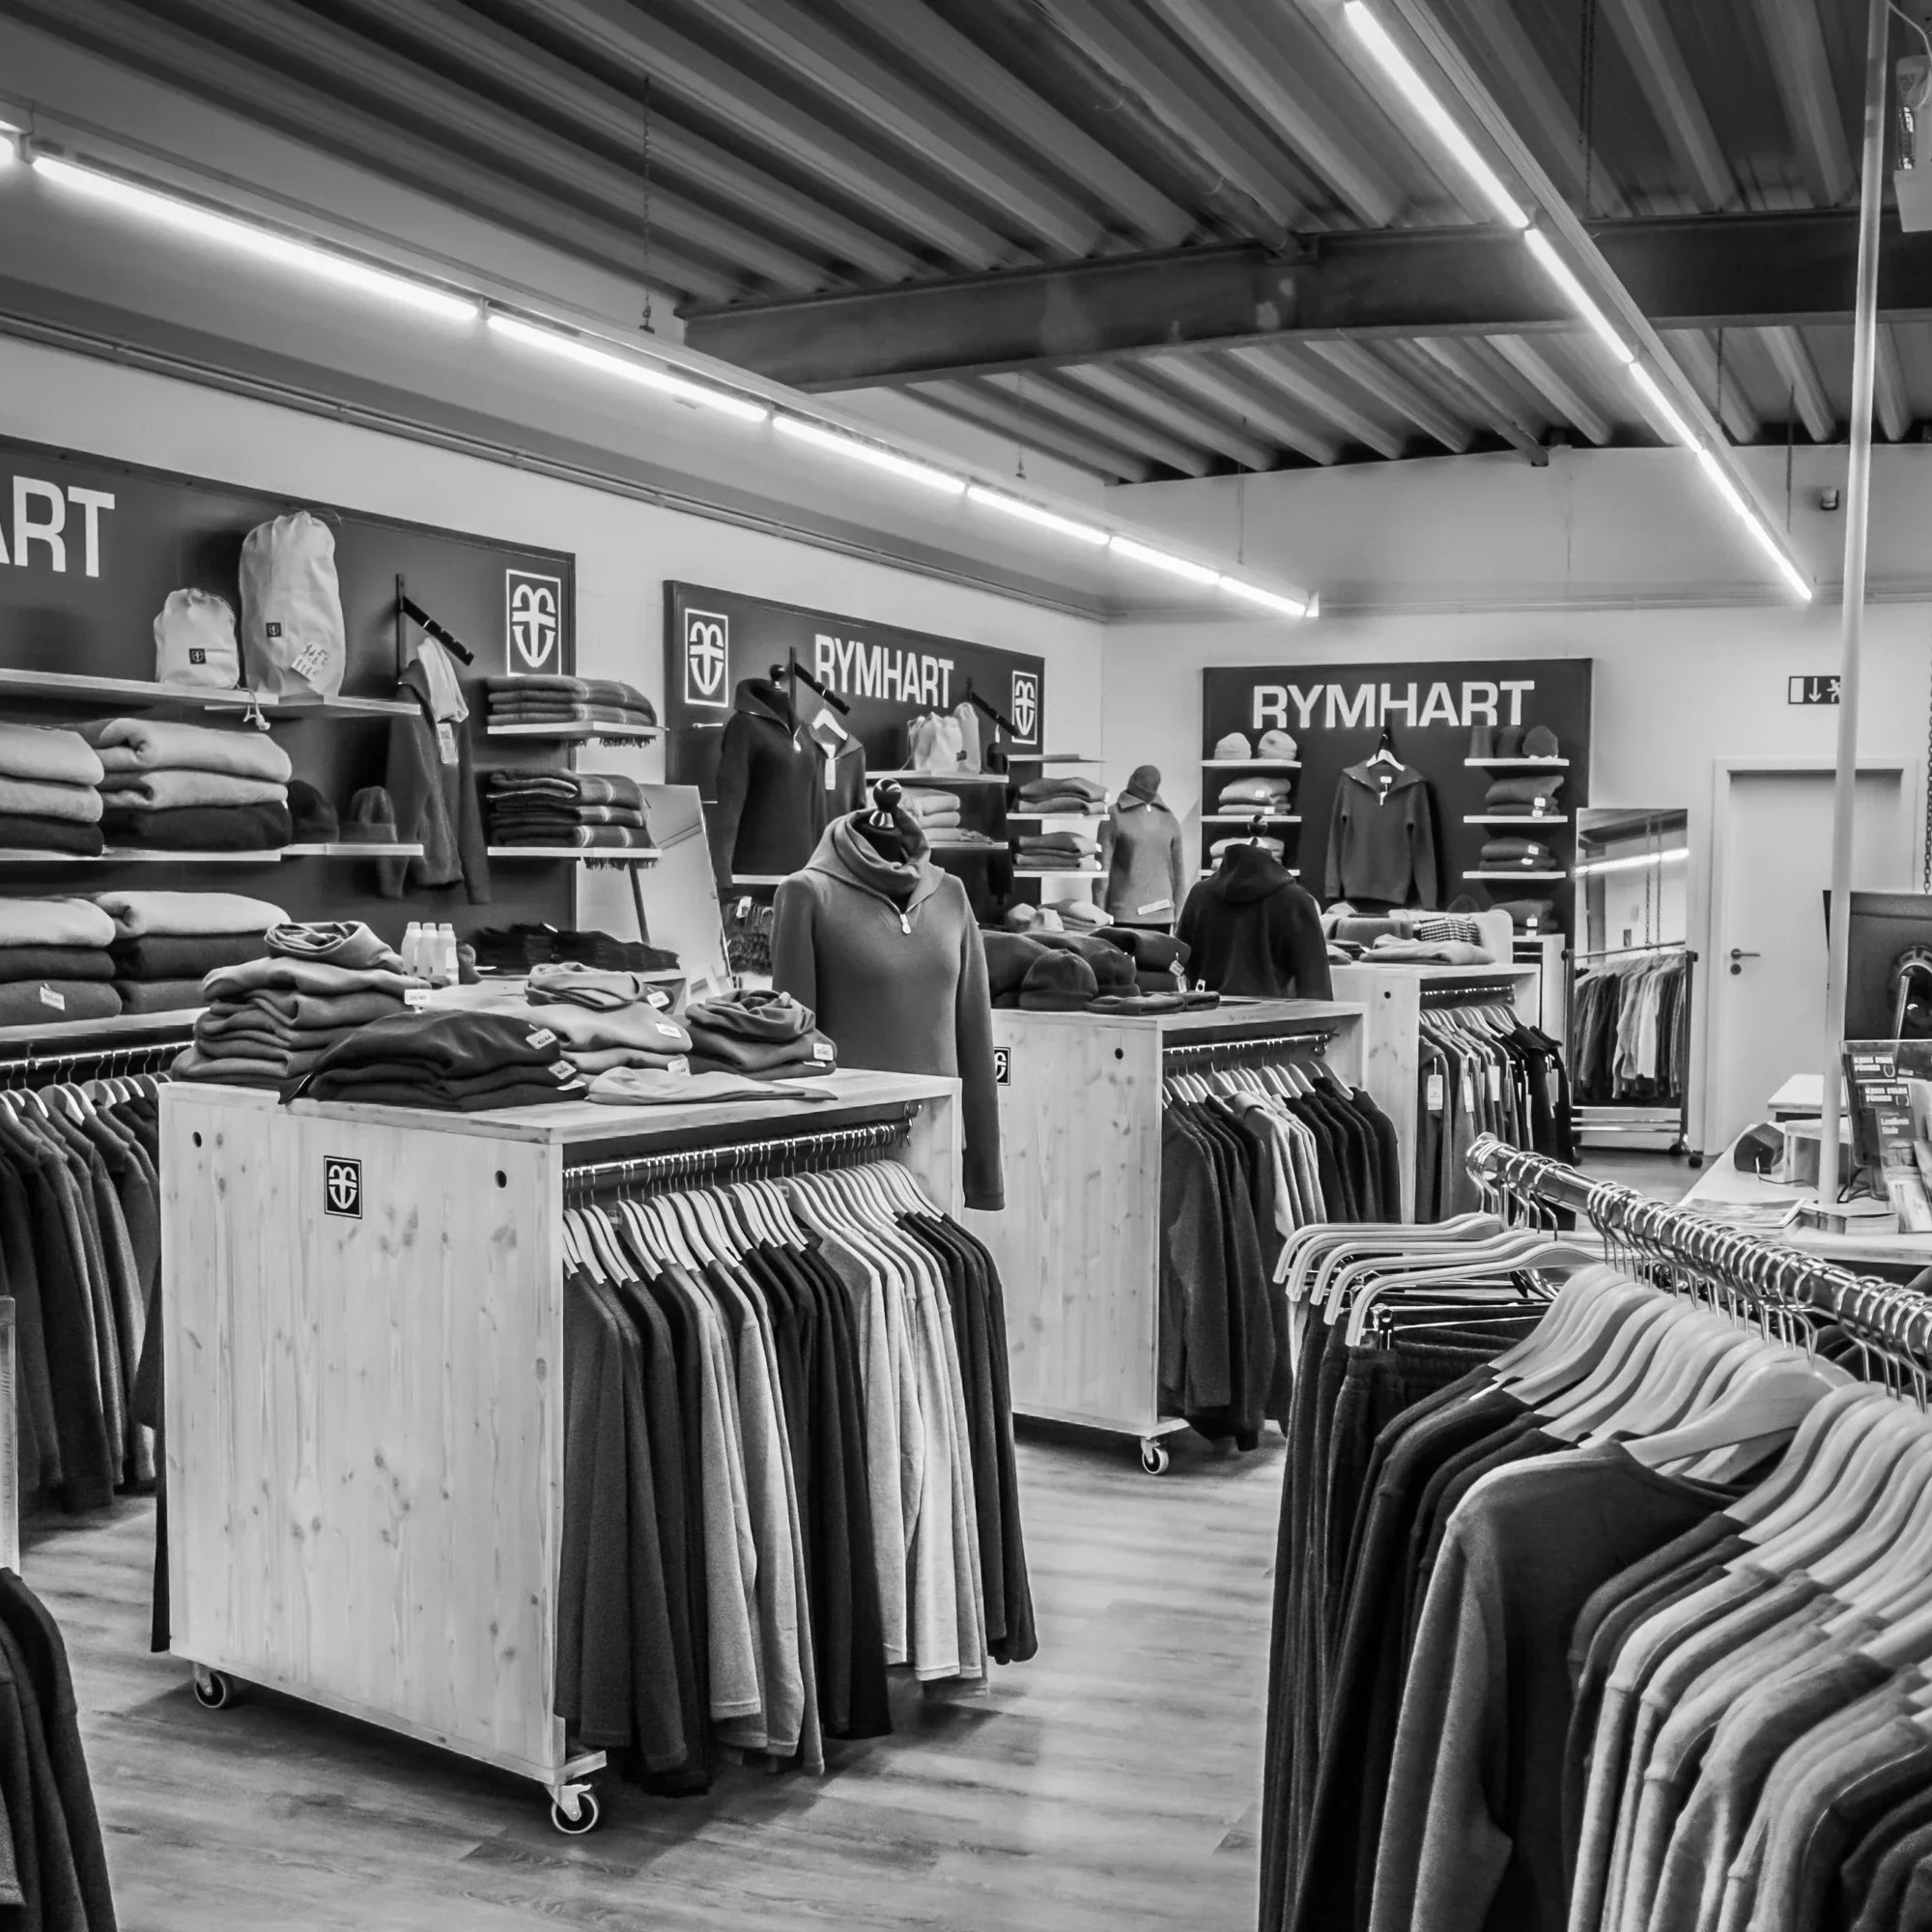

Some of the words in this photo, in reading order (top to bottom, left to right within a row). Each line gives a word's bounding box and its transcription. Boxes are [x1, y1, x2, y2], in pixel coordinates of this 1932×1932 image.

[0, 474, 115, 578] RT
[814, 633, 954, 708] RYMHART
[1253, 680, 1535, 729] RYMHART
